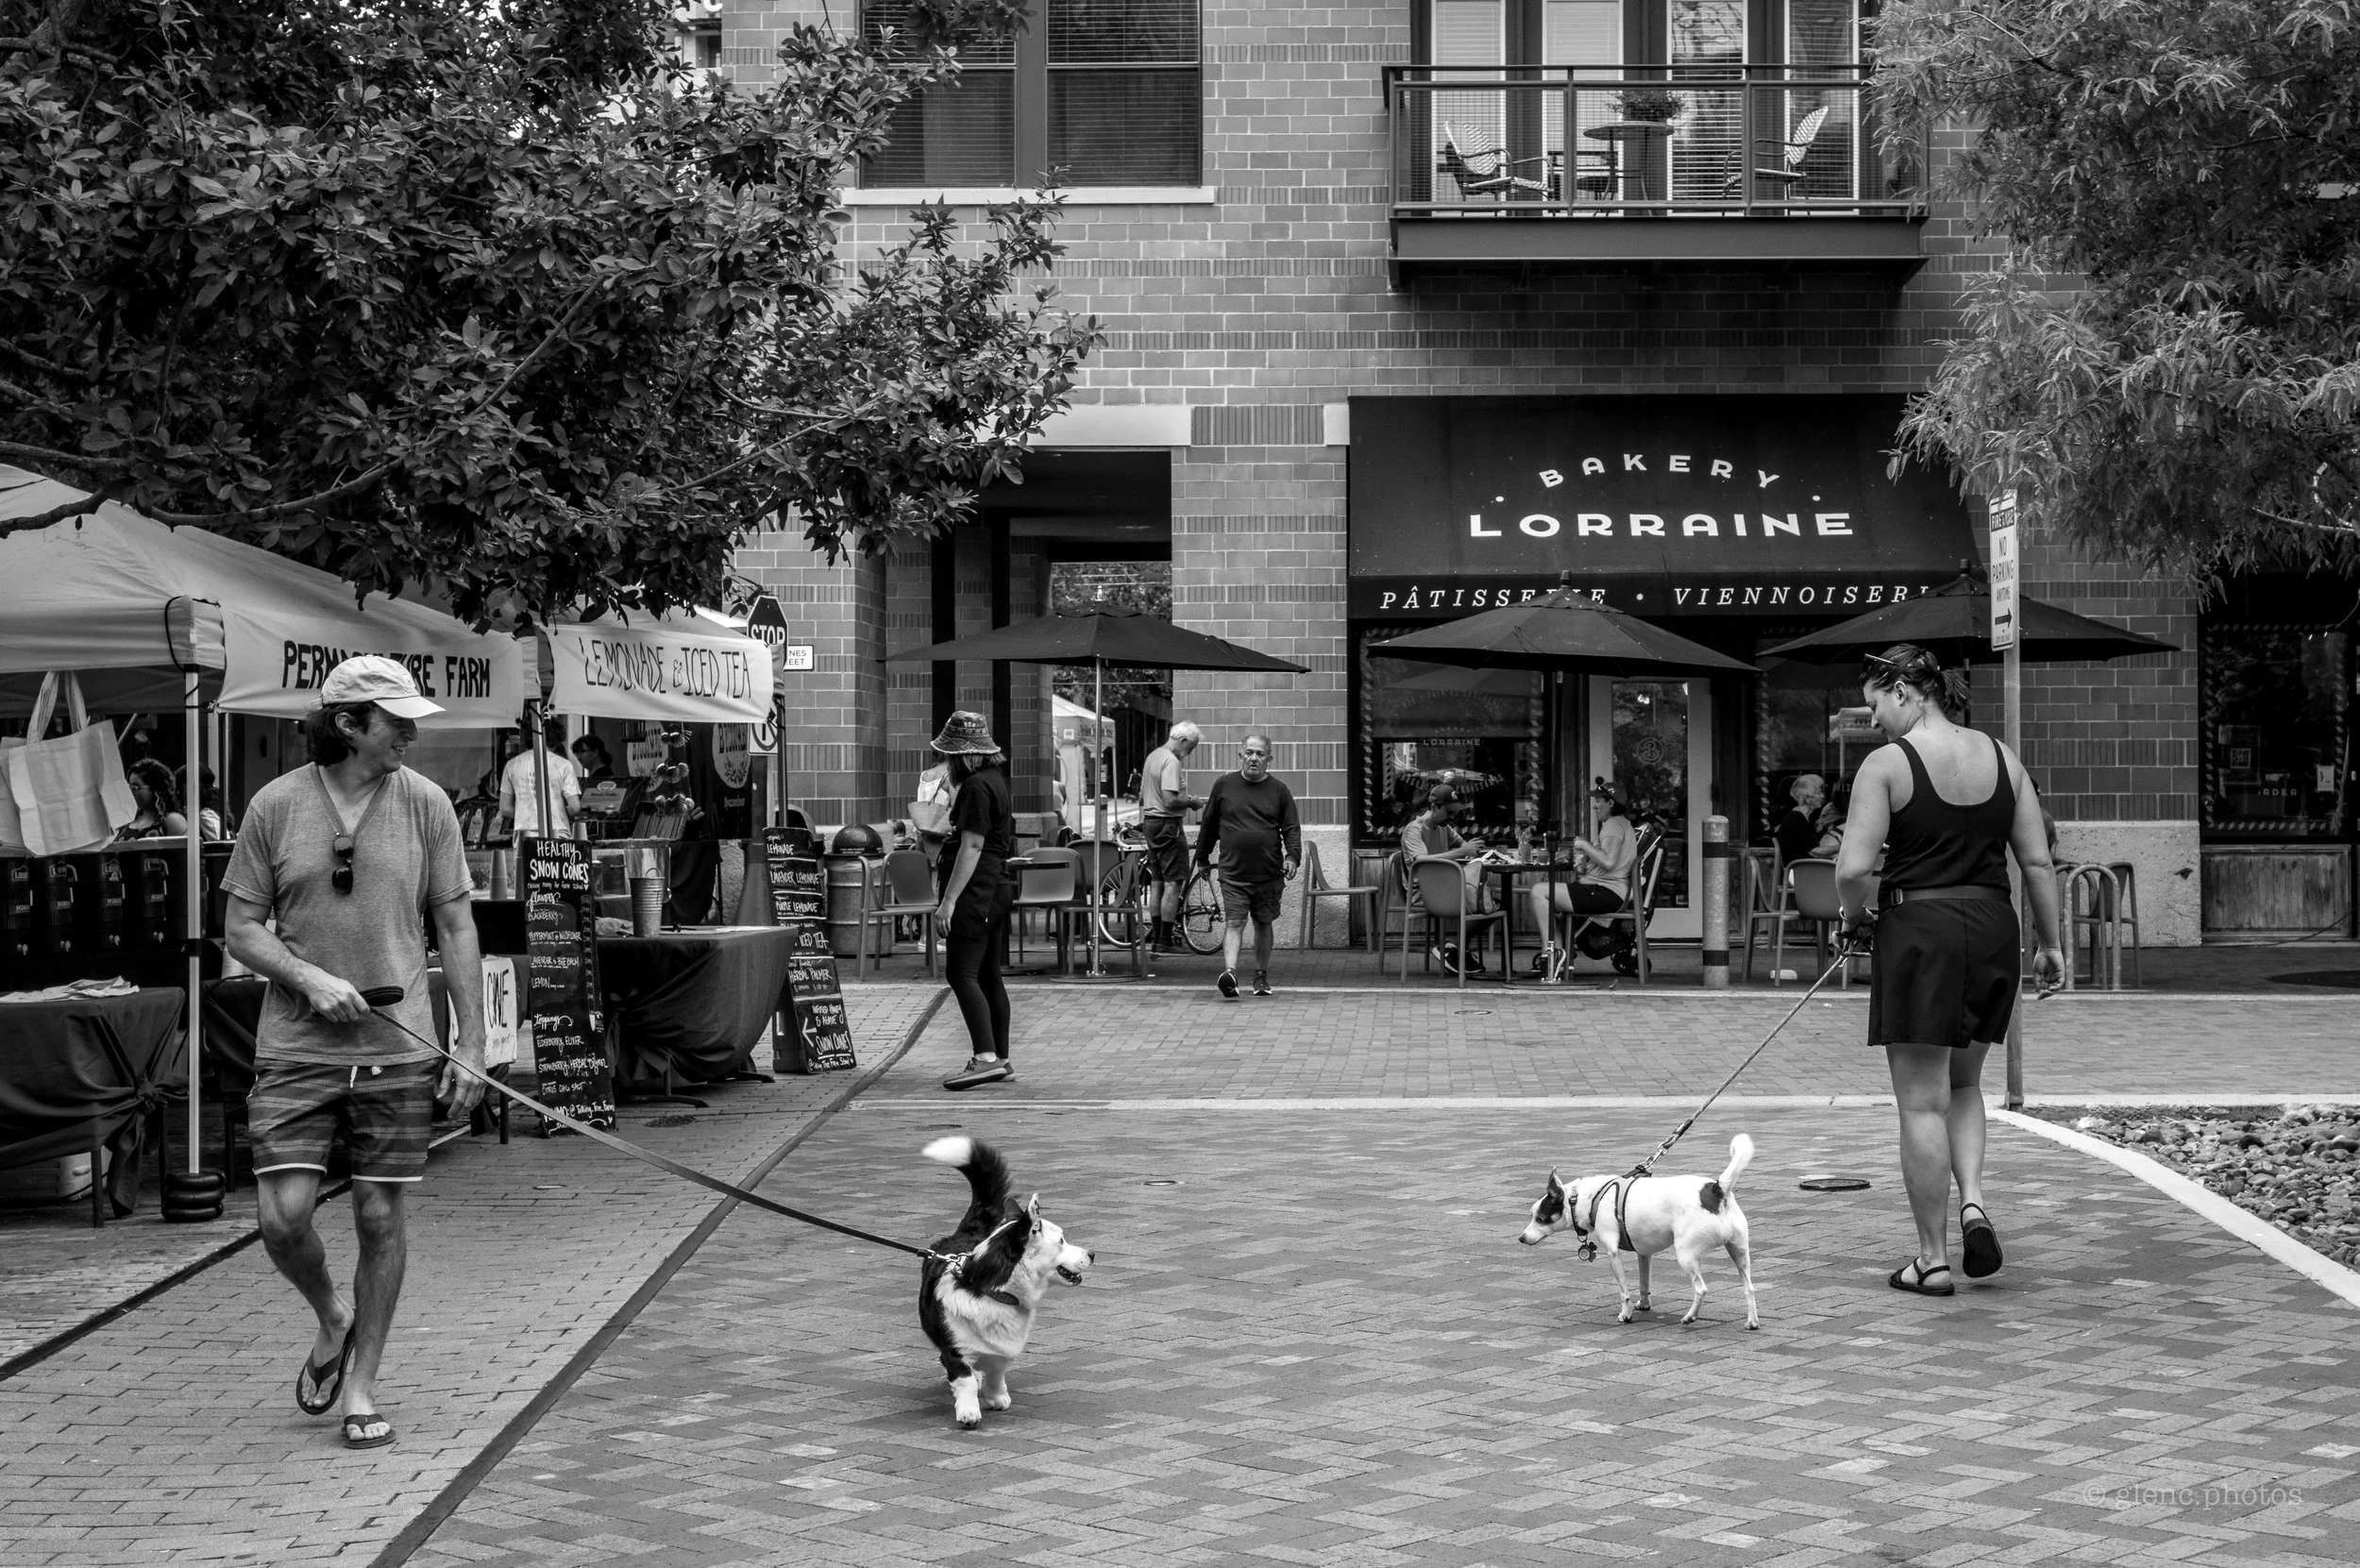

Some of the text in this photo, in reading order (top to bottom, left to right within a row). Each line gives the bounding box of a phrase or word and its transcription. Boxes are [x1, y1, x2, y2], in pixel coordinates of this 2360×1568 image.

[1539, 453, 1780, 488] BAKERY
[1470, 513, 1853, 537] LORRAINE
[1999, 536, 2007, 556] NO
[1993, 560, 2014, 583] PARKING
[1380, 585, 1606, 609] PÂTISSEE
[446, 656, 490, 697] FARM
[579, 637, 666, 694] LEMONADE
[682, 648, 719, 697] ICED
[721, 651, 751, 699] TEA
[537, 841, 582, 865] HEALTHY
[767, 844, 794, 854] LEMONADE
[530, 859, 588, 884] SNOW CONES
[770, 871, 819, 885] LAVENDER LEMONADE
[776, 902, 819, 912] PURPLE LEMONADE
[528, 911, 563, 925] BLACKBERRY
[529, 931, 558, 940] PEPPERMINT
[800, 932, 829, 949] ICED TEA
[531, 956, 553, 965] LAVENDER
[531, 976, 550, 988] LEMON
[807, 968, 833, 981] PALMER
[537, 1037, 565, 1053] ELDERBERRY
[816, 1031, 851, 1055] SNOW CONES
[539, 1060, 569, 1076] STRAWBERRY
